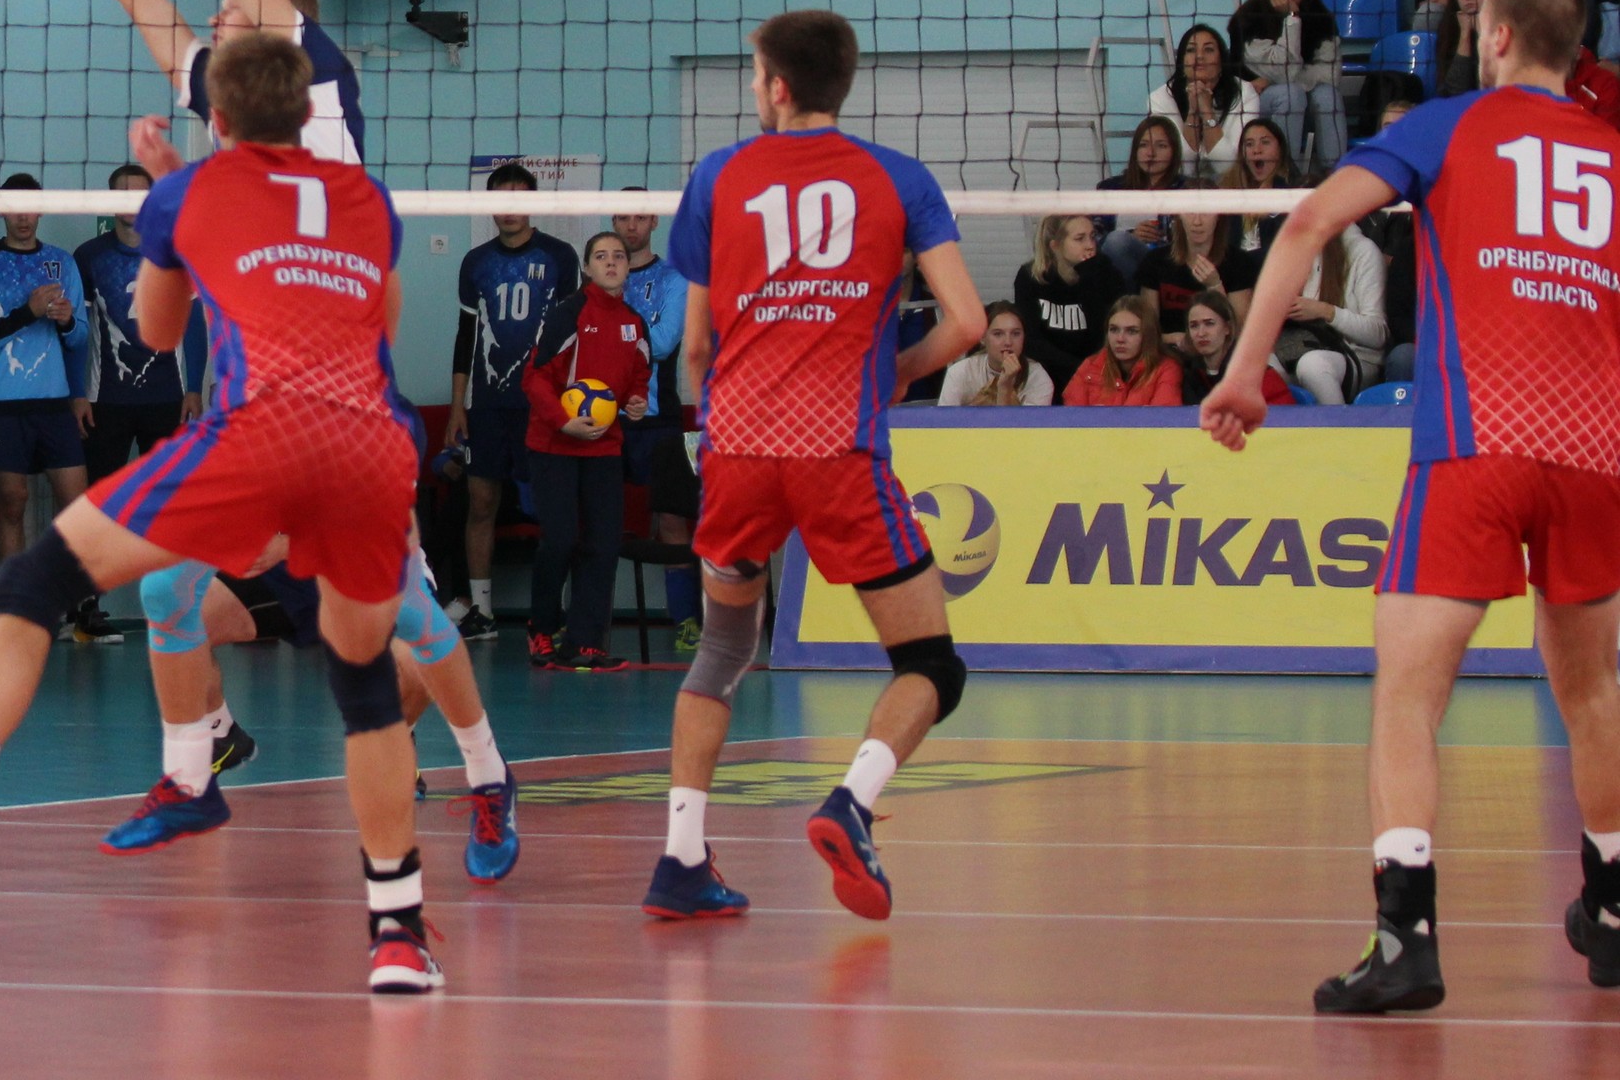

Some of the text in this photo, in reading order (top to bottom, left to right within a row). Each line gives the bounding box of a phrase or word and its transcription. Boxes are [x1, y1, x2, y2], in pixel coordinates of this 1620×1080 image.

[268, 173, 328, 239] 7
[1497, 135, 1613, 250] 15
[745, 180, 856, 276] 10
[43, 261, 61, 280] 17
[275, 267, 367, 301] ОБЛАСТЬ
[496, 281, 530, 320] 10
[737, 280, 869, 311] ОНБУРГСКАЯ
[1512, 277, 1598, 312] ОБЛАСТЬ
[754, 304, 836, 323] ОБЛАСТЬ
[953, 550, 987, 562] MIKASA
[1025, 503, 1390, 587] MIKAS
